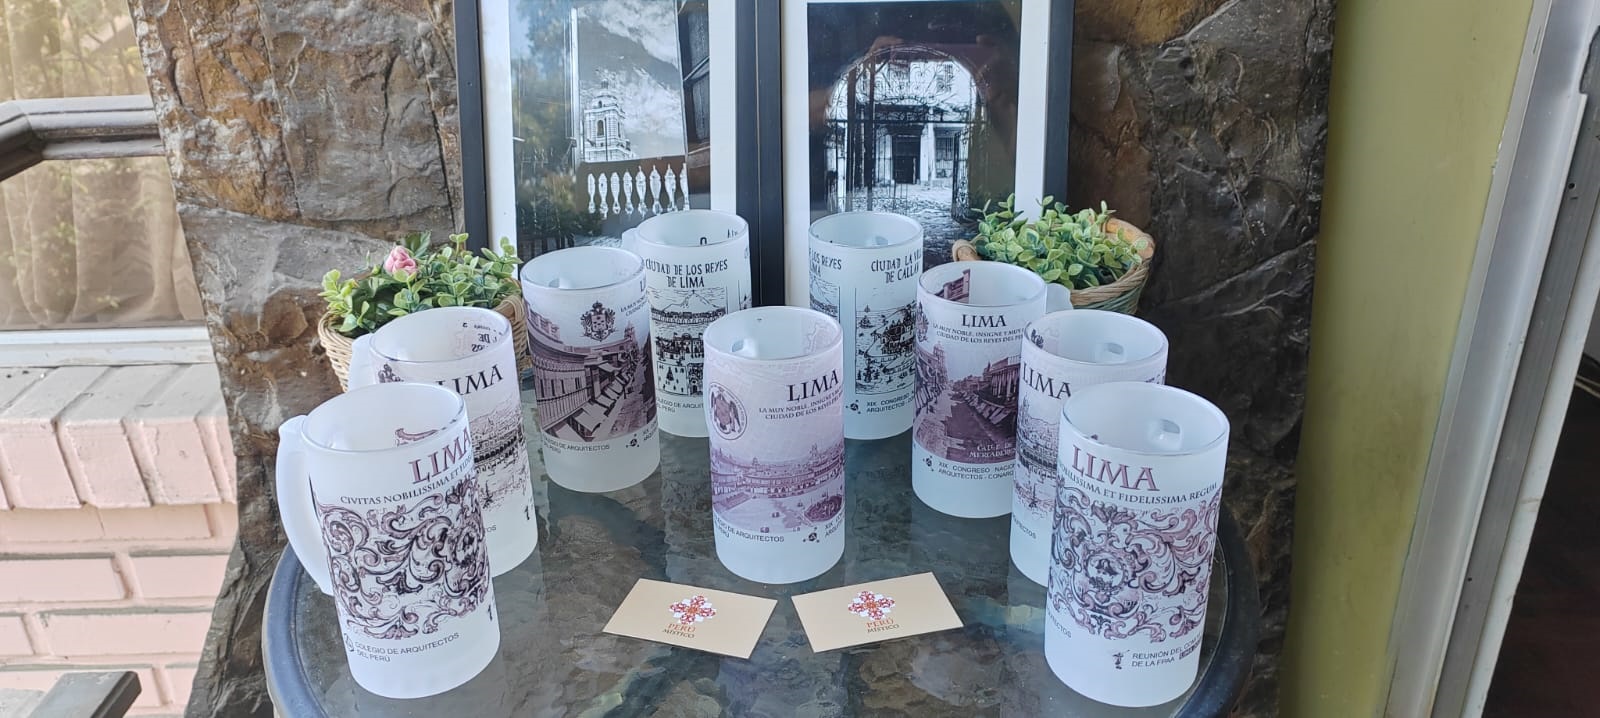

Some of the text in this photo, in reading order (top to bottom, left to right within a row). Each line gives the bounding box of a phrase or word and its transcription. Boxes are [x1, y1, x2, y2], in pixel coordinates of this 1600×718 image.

[645, 258, 728, 276] CIUDAD DE LOS REYES
[821, 255, 842, 270] REYES
[871, 258, 901, 273] CIUDAD
[666, 275, 677, 288] DE
[885, 271, 894, 283] DE
[961, 313, 1009, 329] LIMA
[436, 363, 503, 396] IMA
[786, 369, 839, 403] LIMA
[1022, 361, 1072, 400] LIMA
[765, 410, 795, 420] CIUDAD
[796, 410, 805, 418] DE
[805, 406, 817, 415] LOS
[768, 406, 785, 414] MUY
[866, 400, 906, 413] ARQUITECTOS
[408, 426, 472, 485] LIMA
[938, 468, 983, 480] ARQUITECTOS
[952, 465, 992, 474] CONGRESO
[1072, 444, 1161, 492] LIMA
[340, 495, 382, 506] CIVITAS
[383, 474, 450, 504] NOBILISSIMA
[1103, 487, 1117, 500] ET
[1118, 491, 1187, 505] FIDELISSIMA
[735, 530, 785, 542] ARQUITECTOS
[355, 632, 460, 655] COLEGIO DE ARQUITECTOS
[1132, 649, 1169, 660] REUNIÓN
[1170, 646, 1182, 655] DEL
